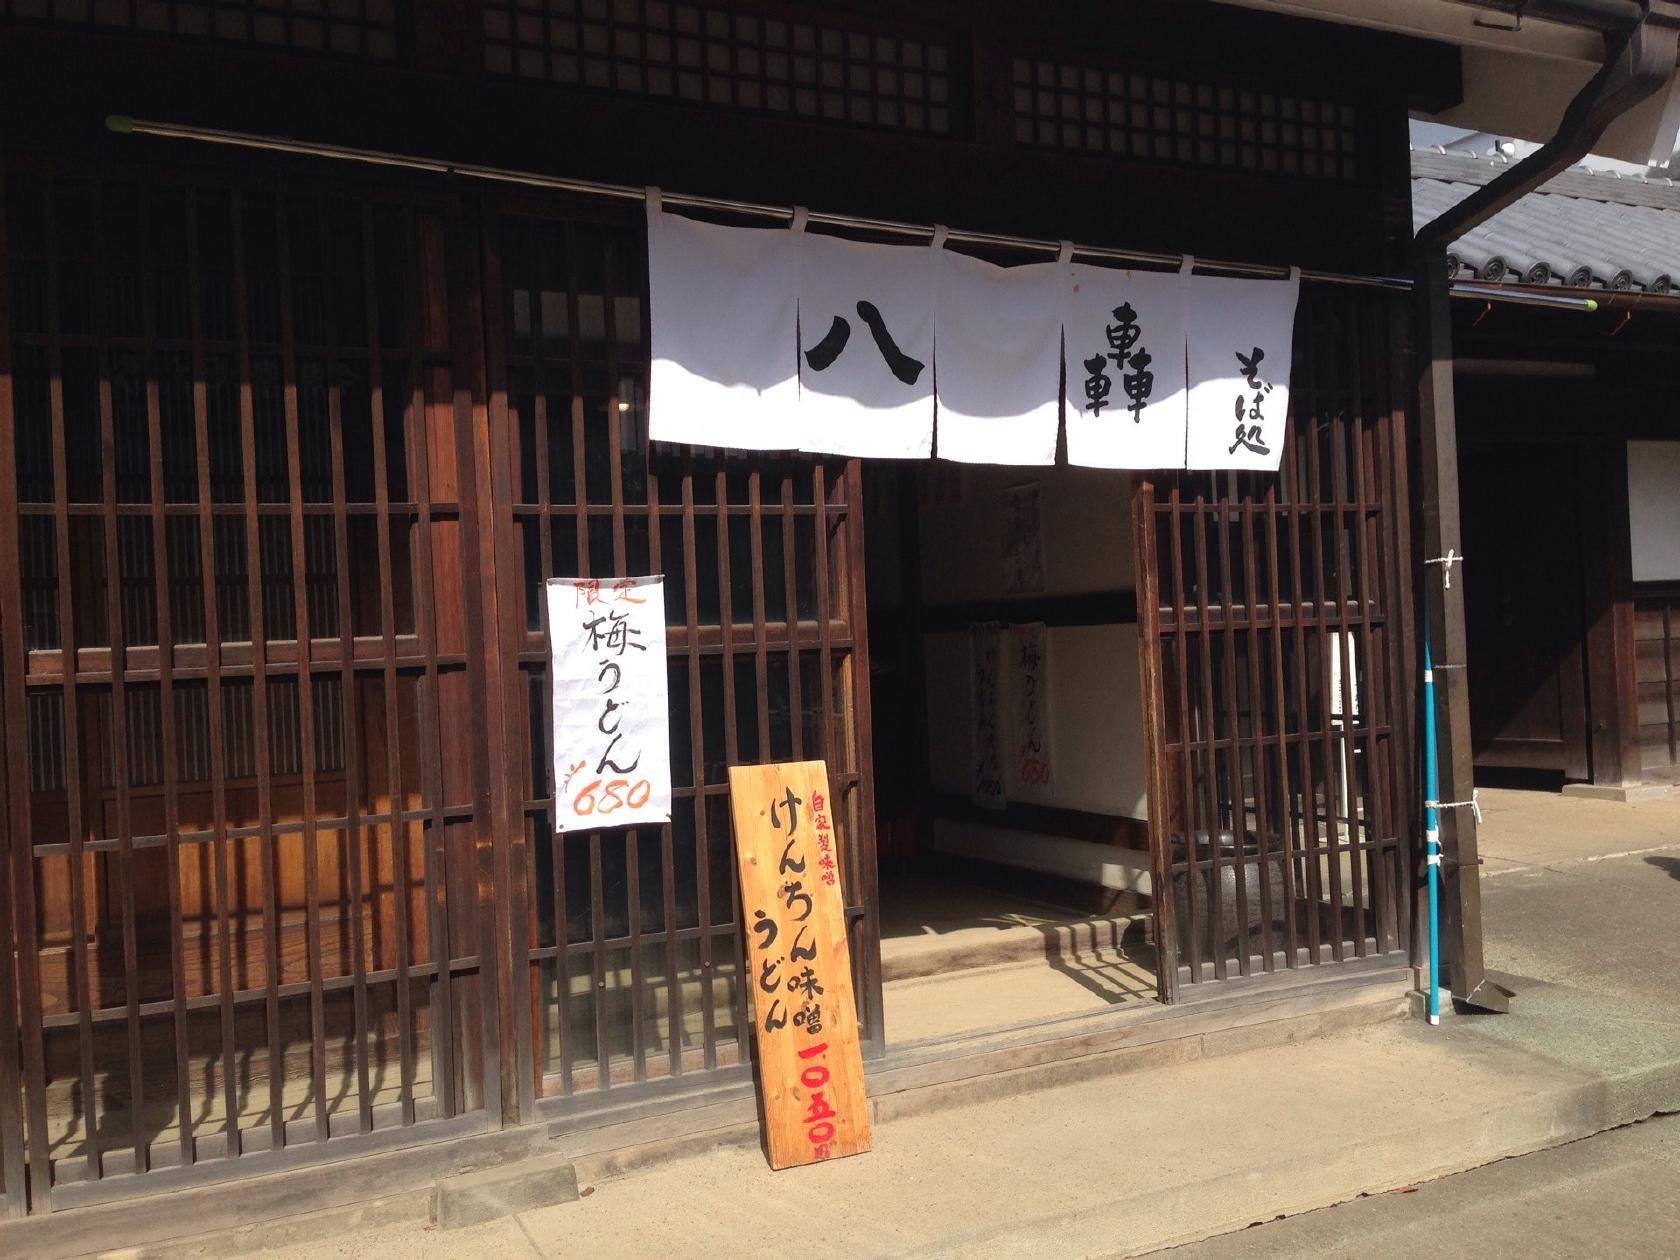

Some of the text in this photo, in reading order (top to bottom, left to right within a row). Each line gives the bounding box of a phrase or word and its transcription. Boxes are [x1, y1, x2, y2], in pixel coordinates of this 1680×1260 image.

[804, 301, 1153, 423] 八 轟
[1229, 346, 1274, 456] そば処
[573, 579, 648, 608] 限定
[582, 609, 647, 775] 梅うどん
[812, 790, 837, 887] 自家製味噌
[753, 909, 788, 1033] うどん
